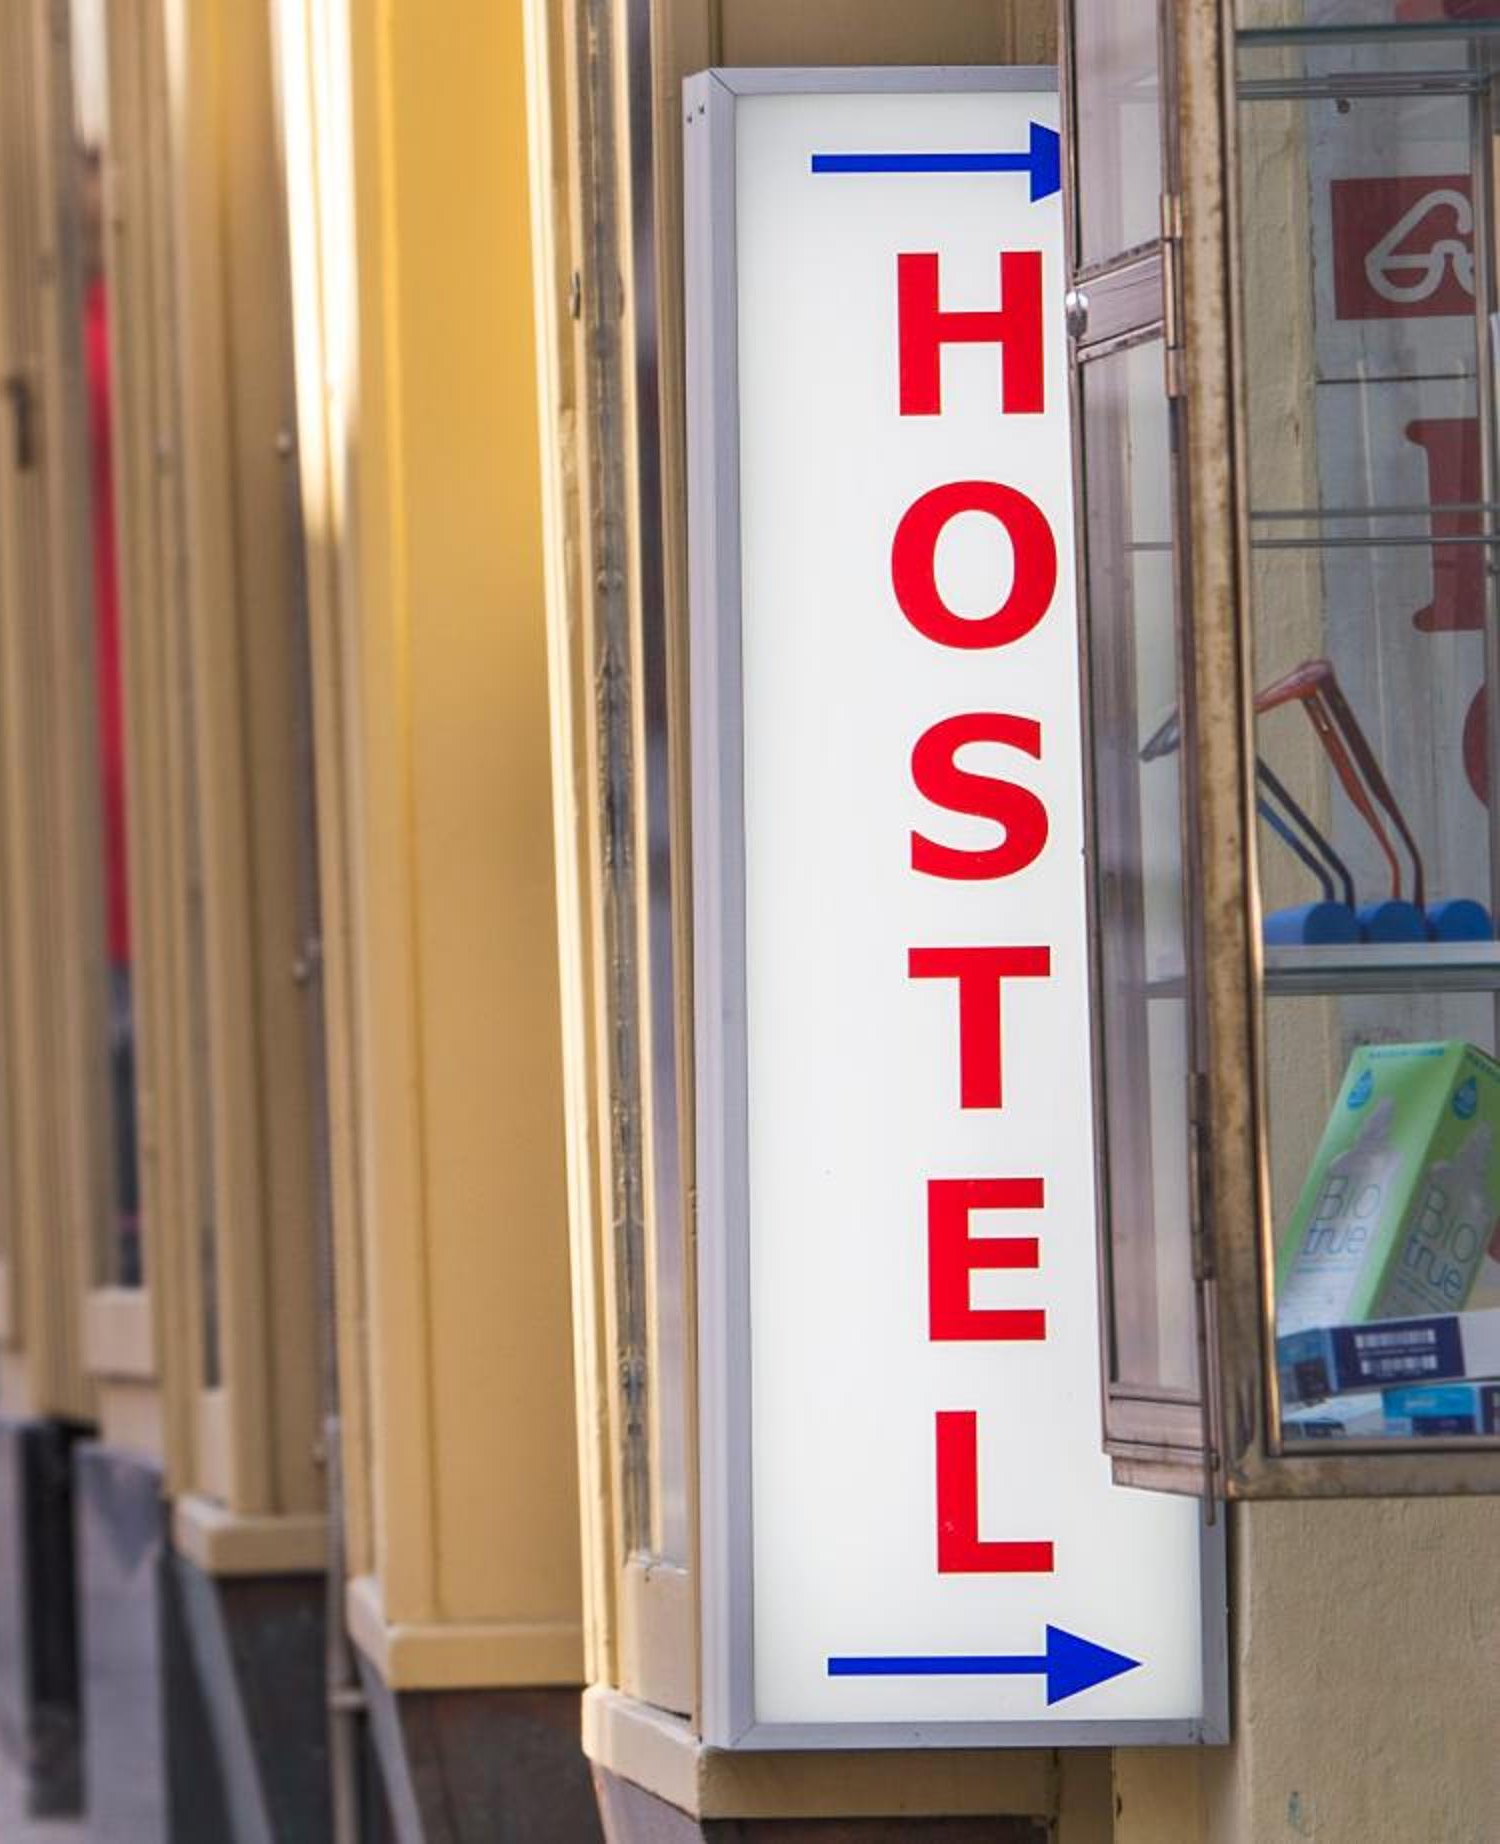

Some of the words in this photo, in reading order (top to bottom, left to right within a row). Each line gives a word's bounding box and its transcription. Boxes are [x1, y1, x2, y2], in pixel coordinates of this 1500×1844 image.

[891, 251, 1057, 1573] HOSTEL
[1301, 1223, 1367, 1256] true
[1403, 1231, 1463, 1300] true
